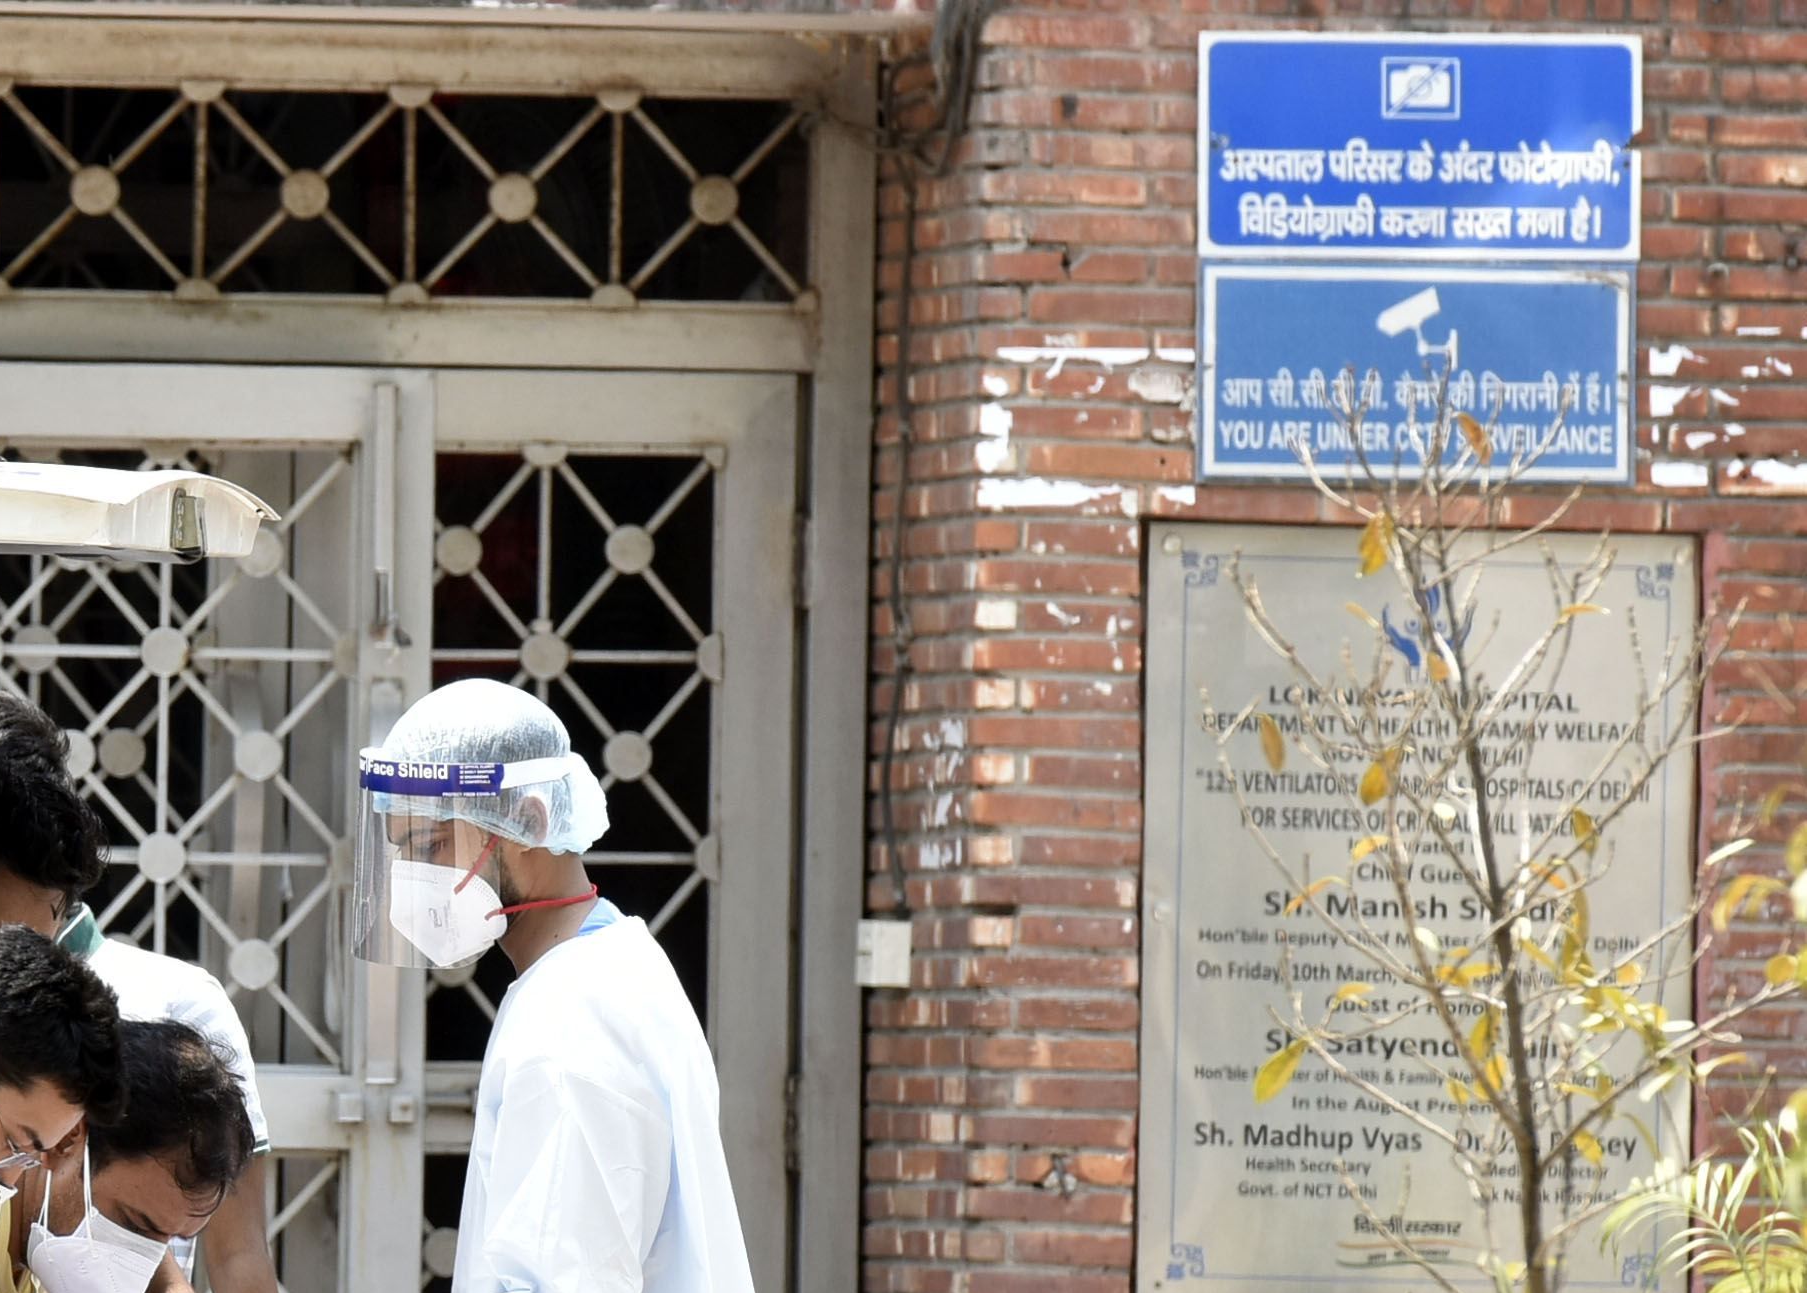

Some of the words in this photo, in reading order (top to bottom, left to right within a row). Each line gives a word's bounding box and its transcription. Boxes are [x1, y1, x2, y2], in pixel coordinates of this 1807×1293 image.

[1220, 148, 1325, 184] अस्पताल
[1328, 137, 1404, 184] परिसर
[1405, 138, 1435, 183] के
[1438, 138, 1494, 184] अंदर
[1497, 138, 1621, 190] फोटोग्राफी,
[1239, 191, 1376, 243] विडियोग्राफी
[1380, 205, 1447, 239] करना
[1451, 206, 1513, 240] सख्त
[1515, 206, 1567, 240] मना
[1222, 377, 1263, 408] आप
[1219, 419, 1265, 450] YOU
[1267, 420, 1313, 450] ARE
[1456, 422, 1613, 454] SRVEILLANCE
[1336, 686, 1427, 709] NYA
[1438, 687, 1578, 712] HPITAL
[1202, 712, 1334, 736] DEPAMENT
[368, 755, 395, 777] Face
[398, 763, 449, 780] Shield
[1471, 777, 1566, 801] OSPTALS
[1599, 780, 1651, 804] DELI
[1281, 806, 1361, 832] SERVICES
[1356, 860, 1413, 881] Chif
[1325, 892, 1447, 919] Mansh
[1196, 959, 1222, 980] On
[1292, 963, 1331, 982] 10th
[1315, 1096, 1348, 1112] the
[1194, 1122, 1233, 1147] Sh.
[1243, 1123, 1354, 1155] Madhup
[1362, 1127, 1423, 1155] Vyas
[1245, 1157, 1295, 1173] Health
[1238, 1180, 1277, 1197] Govt.
[1283, 1182, 1299, 1197] of
[1304, 1183, 1333, 1199] NCT
